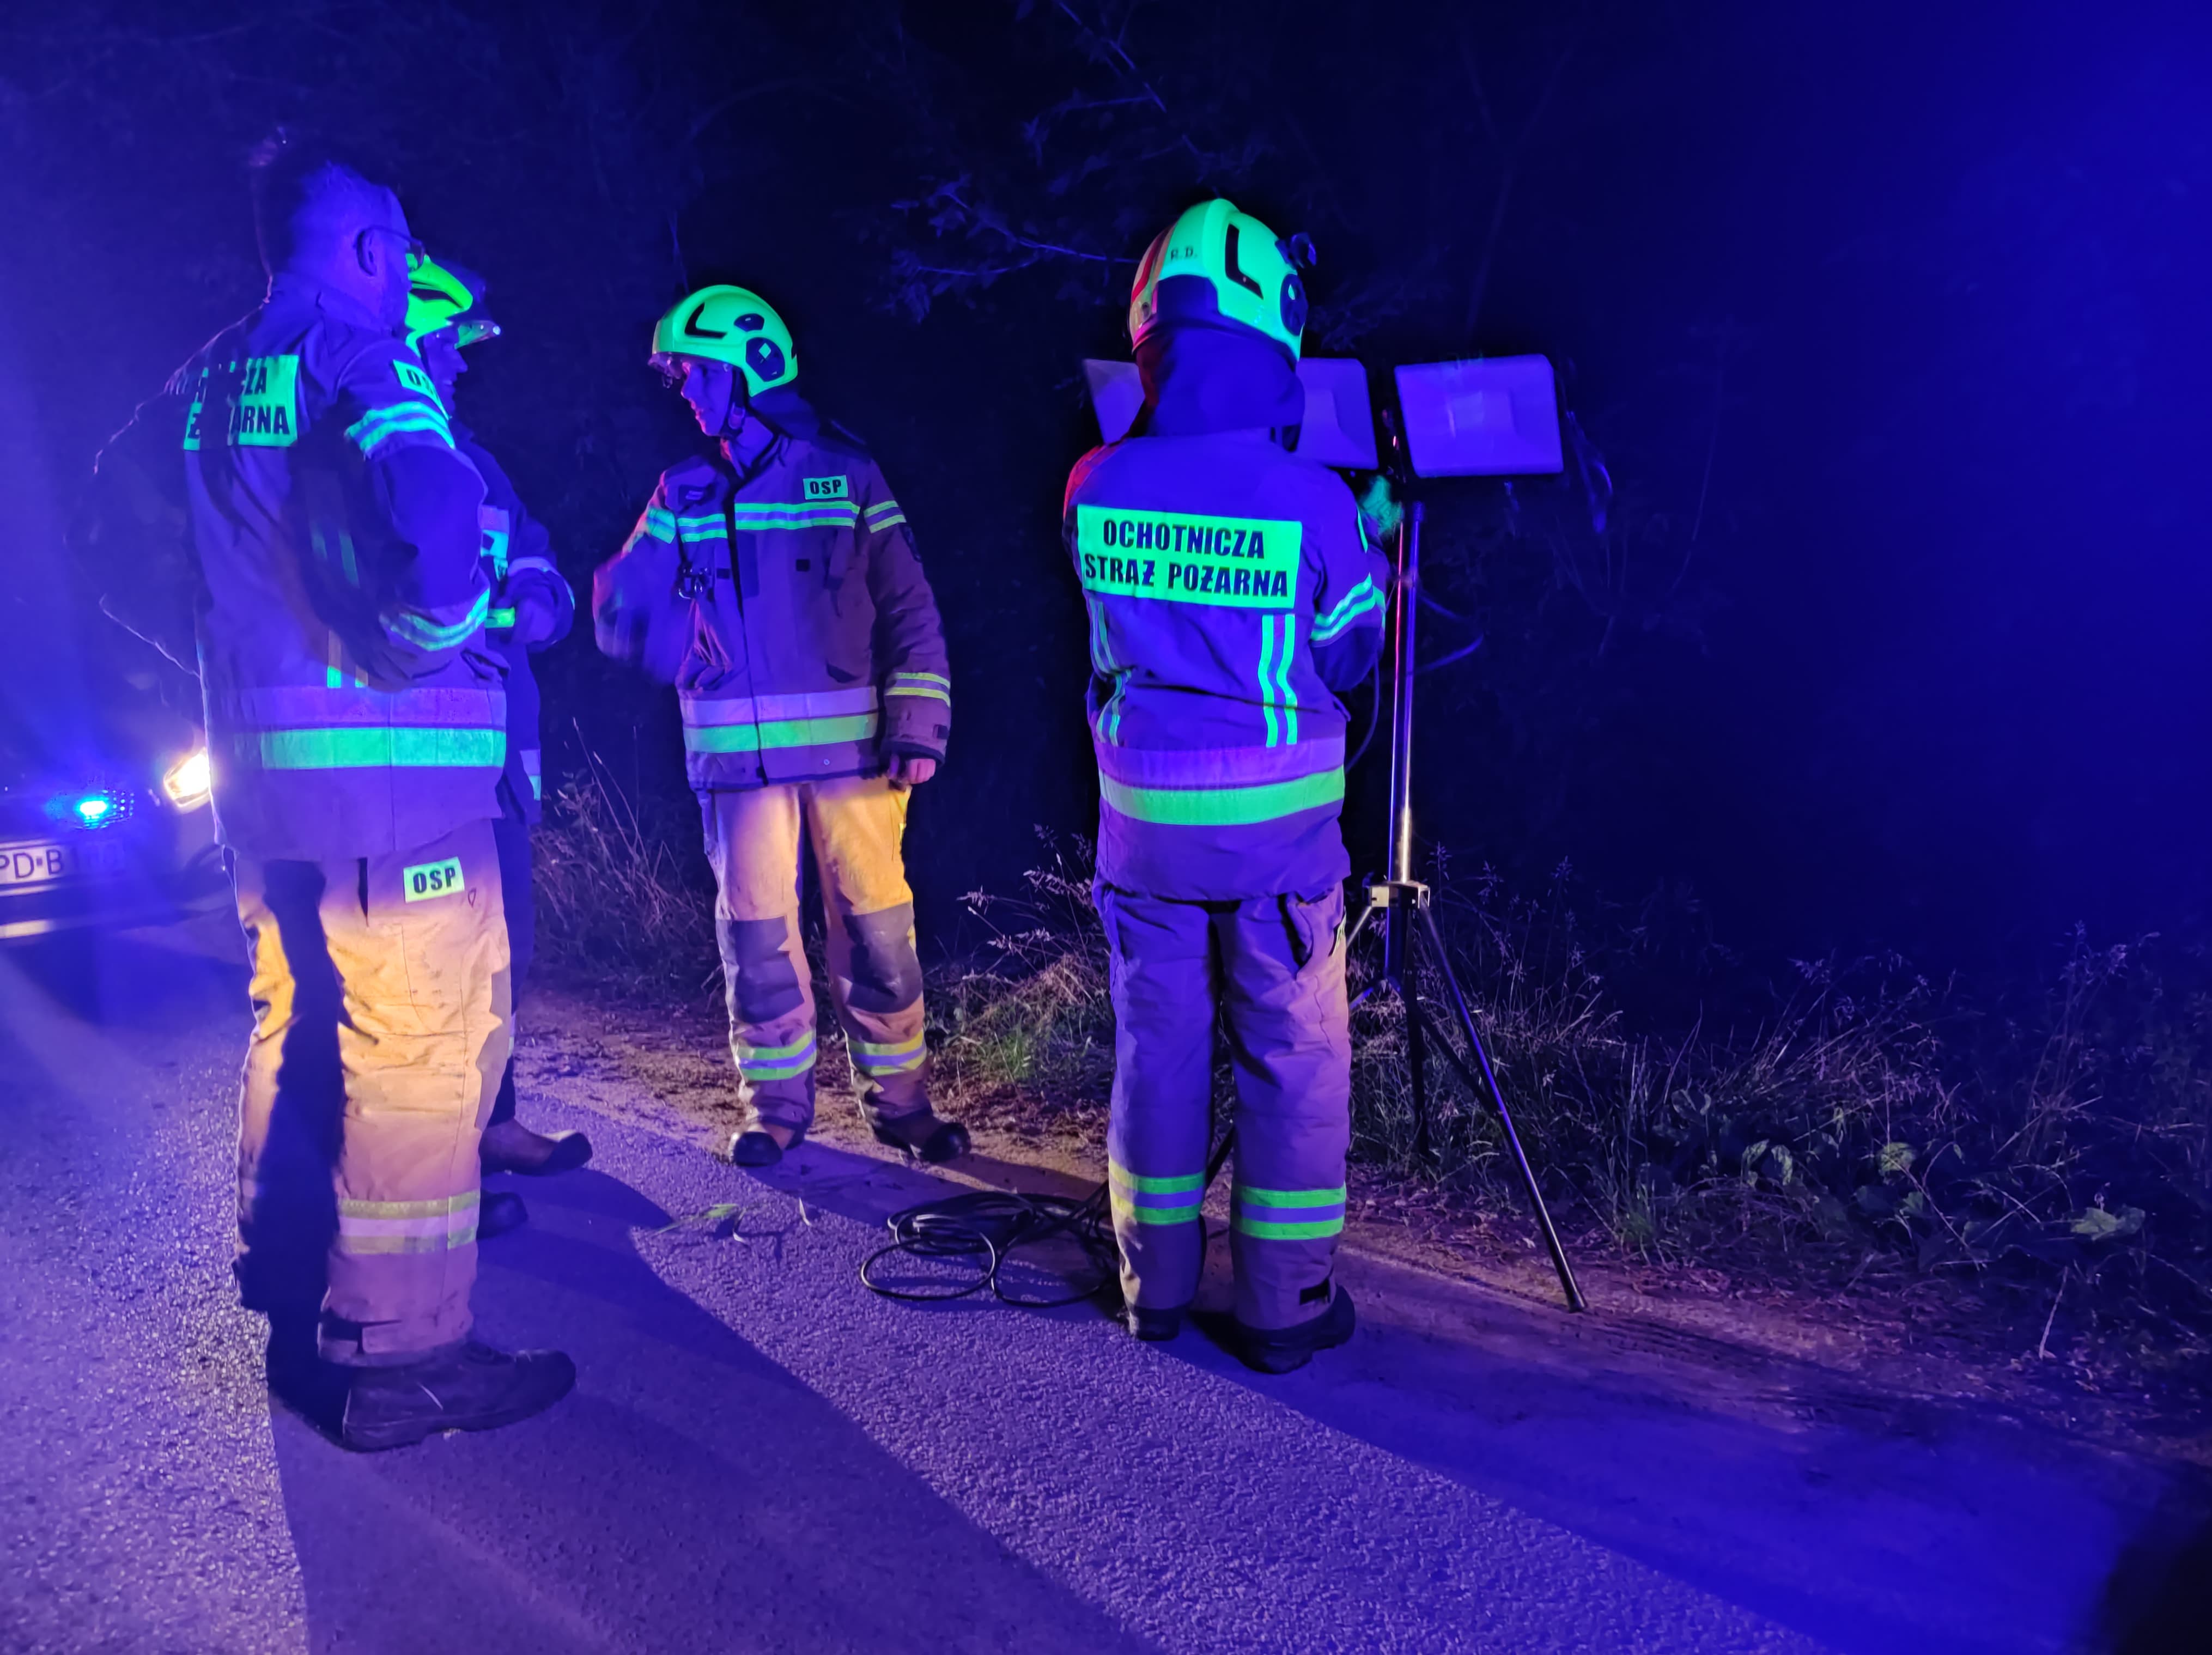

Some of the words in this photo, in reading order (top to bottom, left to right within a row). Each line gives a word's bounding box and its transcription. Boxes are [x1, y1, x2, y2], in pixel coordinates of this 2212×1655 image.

[809, 479, 842, 495] OSP
[1103, 518, 1265, 559] OCHOTNICZA
[413, 867, 456, 893] OSP
